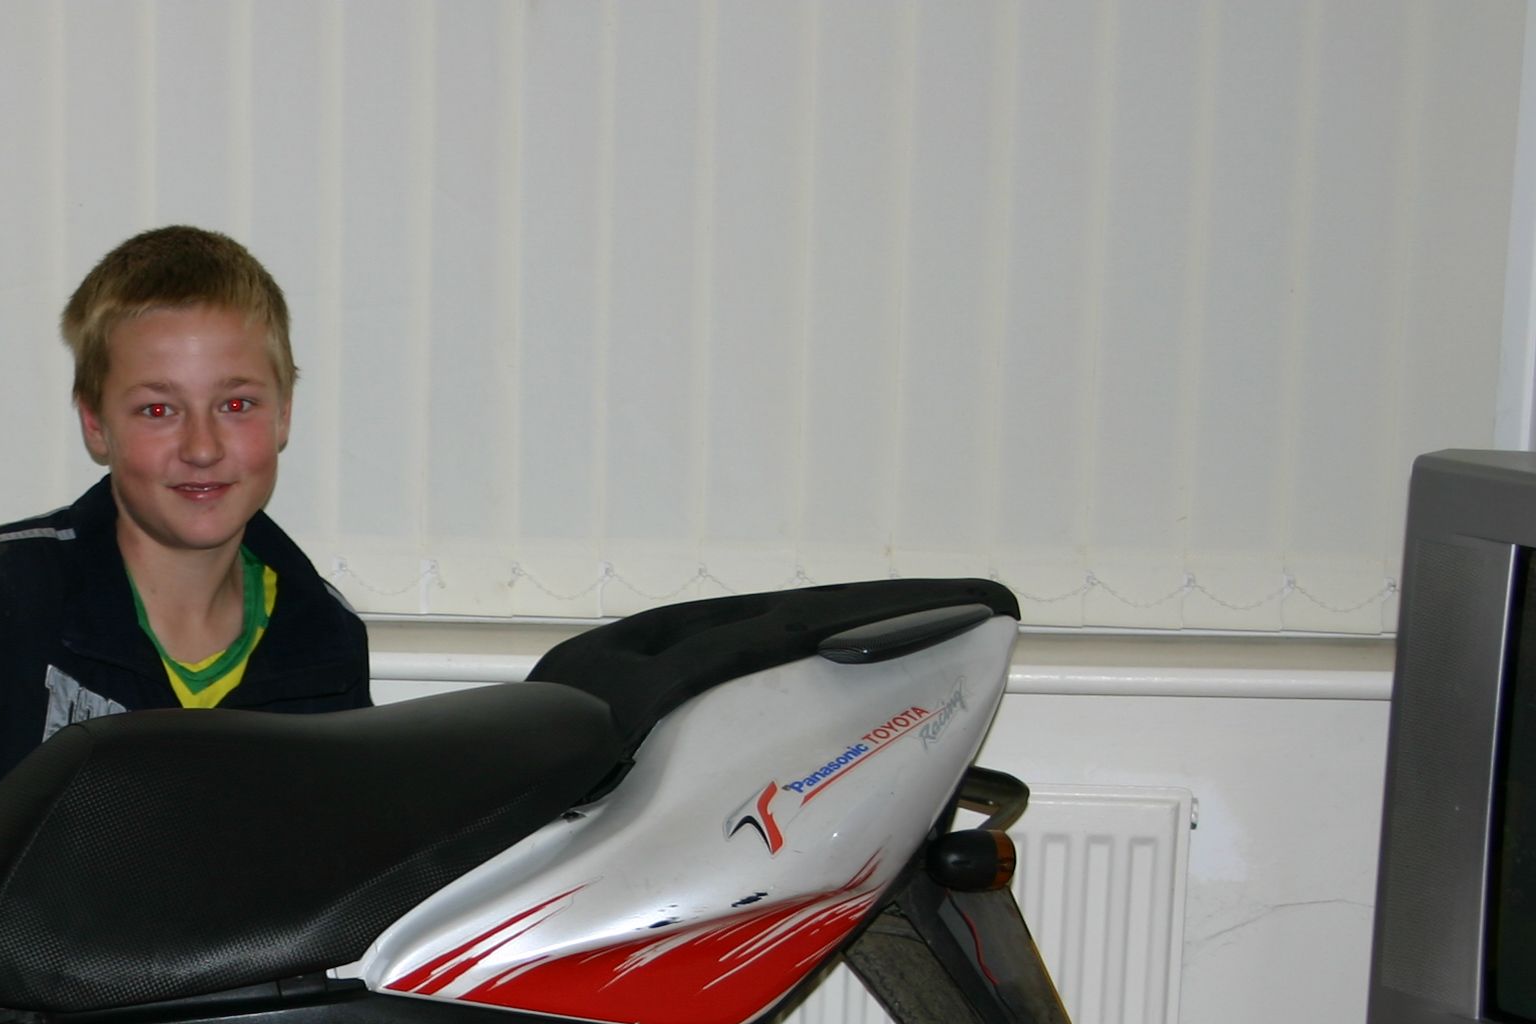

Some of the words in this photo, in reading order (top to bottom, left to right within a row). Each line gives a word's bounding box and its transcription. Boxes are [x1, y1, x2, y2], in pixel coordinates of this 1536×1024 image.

[789, 743, 869, 793] Panasonic
[862, 706, 929, 745] TOYOTA
[919, 677, 969, 750] Racing
